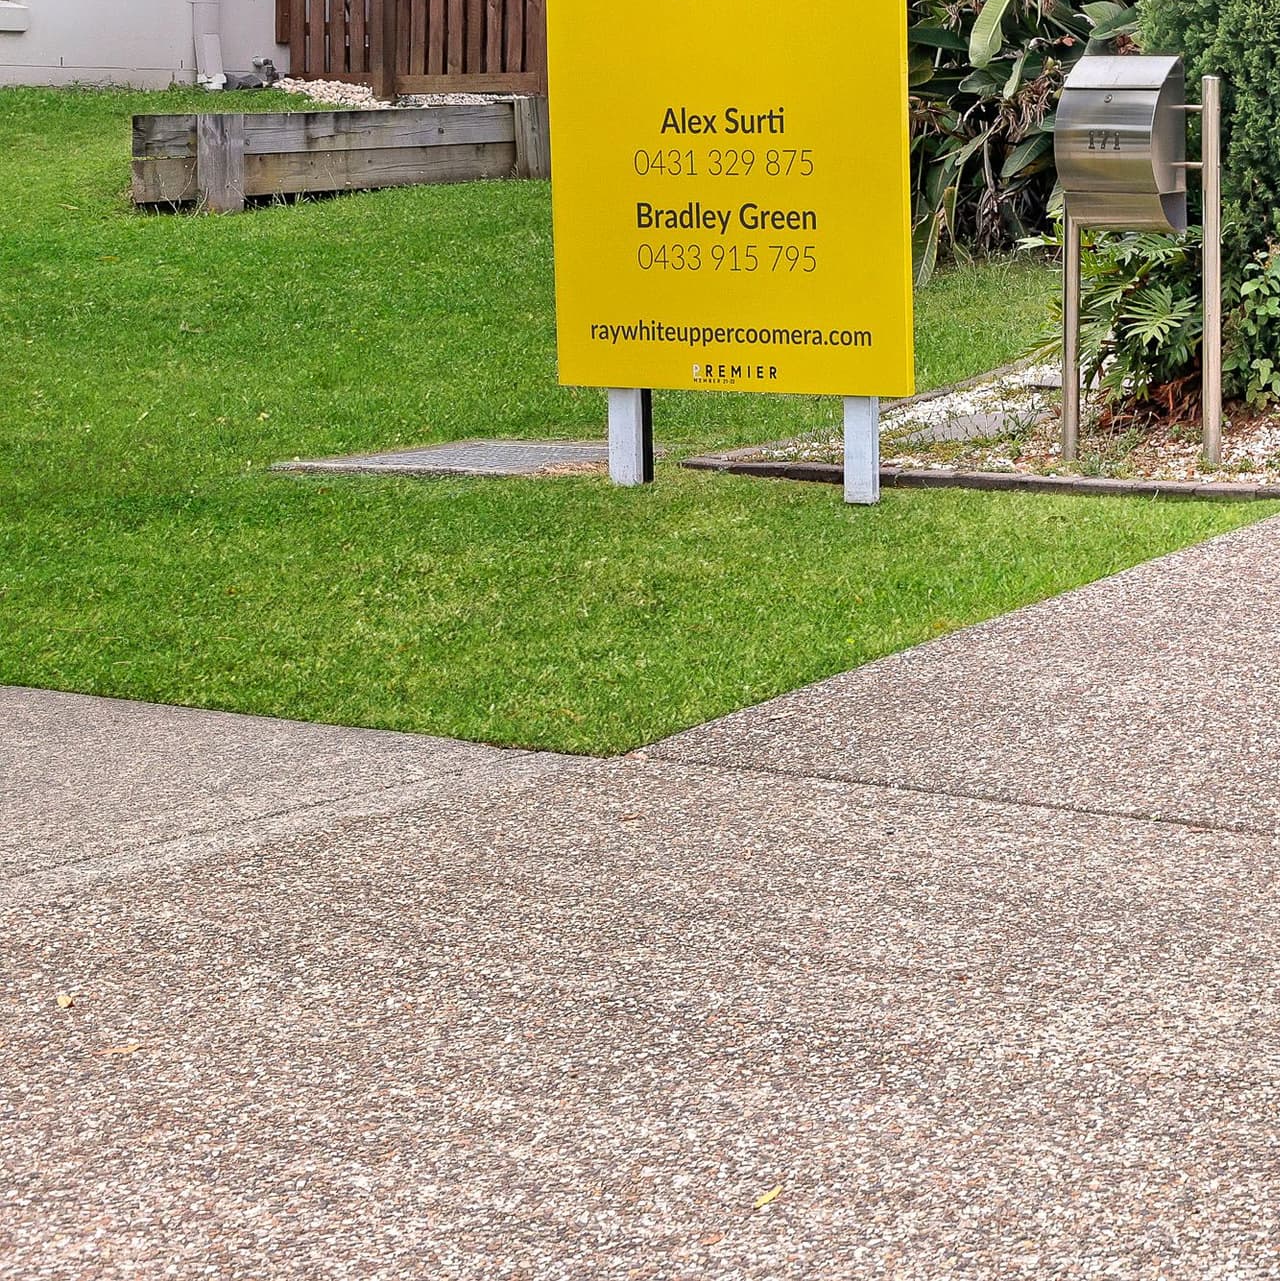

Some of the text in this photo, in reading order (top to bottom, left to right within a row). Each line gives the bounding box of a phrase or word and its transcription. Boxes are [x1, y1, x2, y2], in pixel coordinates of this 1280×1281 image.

[660, 106, 785, 135] Alex Surti
[634, 149, 814, 177] 0431 329 875
[636, 202, 818, 235] Bradley Green
[637, 243, 817, 273] 0433 915 795
[590, 319, 873, 347] raywhiteuppercoomera.com
[692, 364, 777, 380] PREMIER
